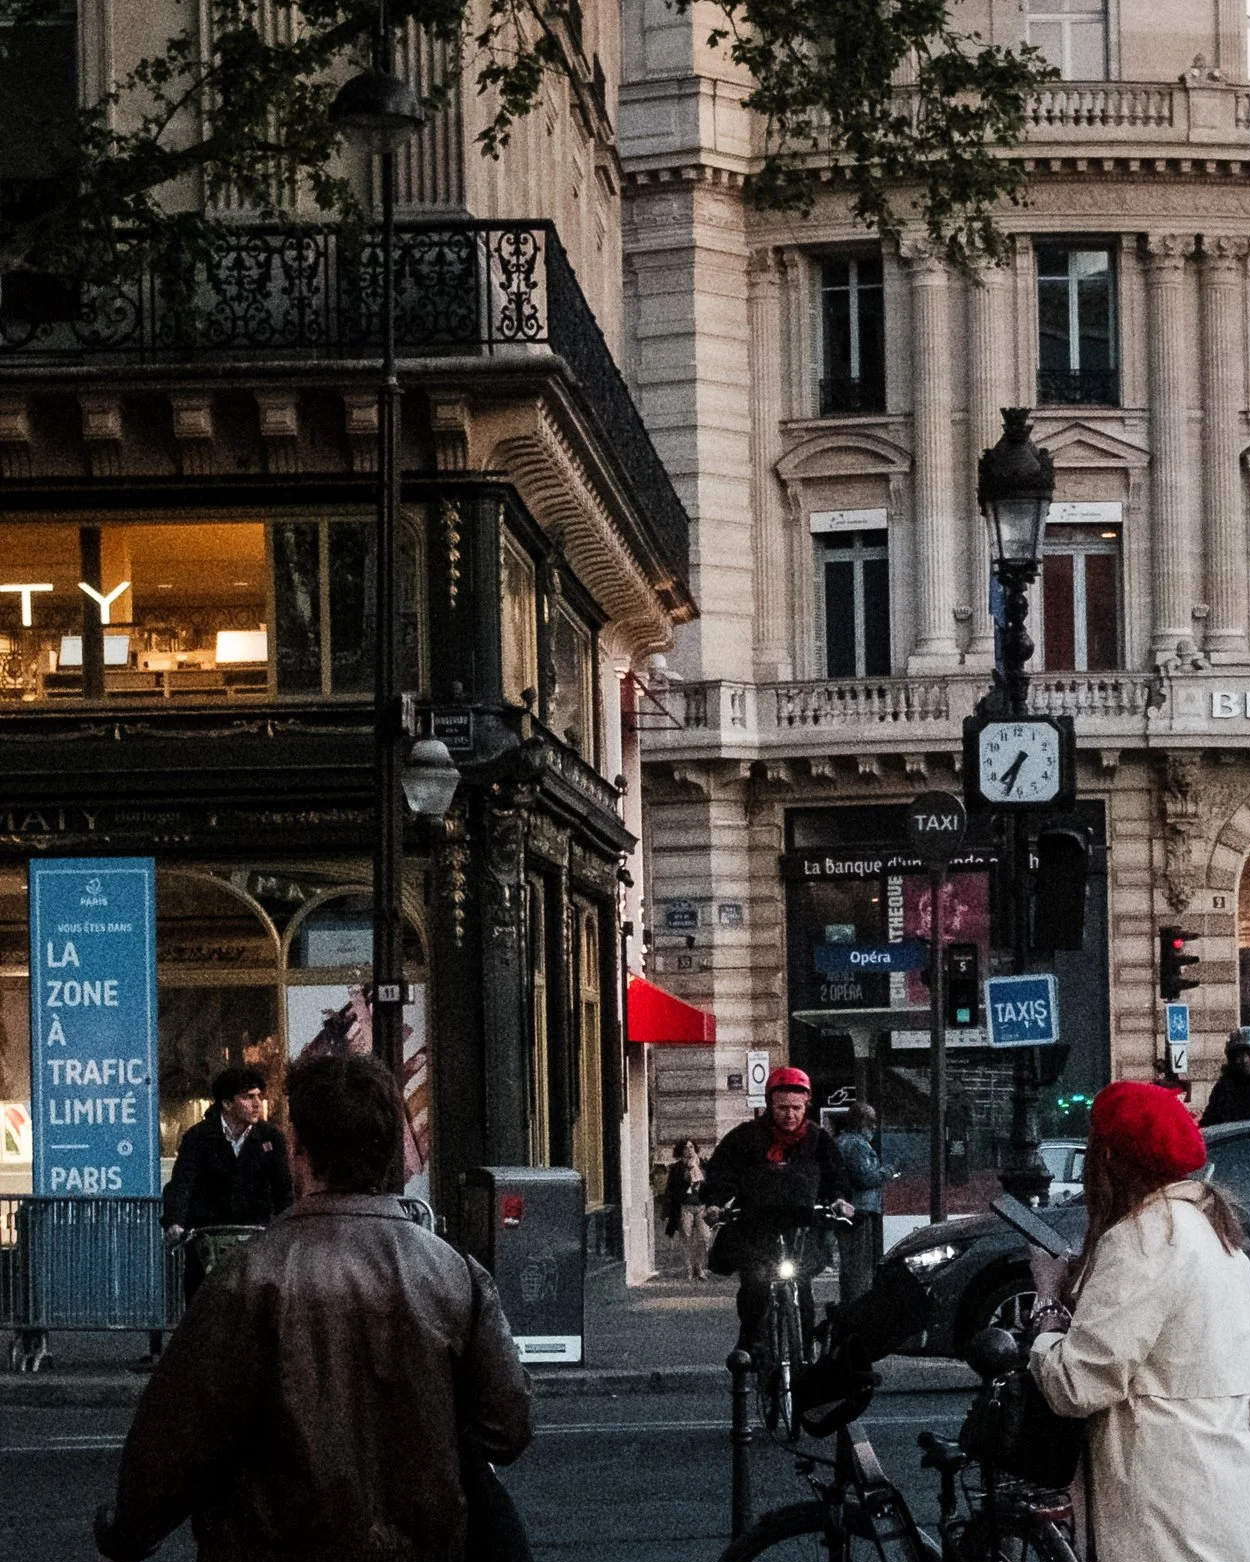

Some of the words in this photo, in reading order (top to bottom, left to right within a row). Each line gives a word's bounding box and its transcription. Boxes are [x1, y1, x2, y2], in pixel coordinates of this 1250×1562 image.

[0, 582, 131, 627] TY
[914, 814, 958, 831] TAXI
[804, 860, 821, 875] La
[80, 897, 108, 906] PARIS
[58, 923, 82, 933] VOUS
[107, 923, 132, 933] DANS
[47, 941, 80, 967] LA
[849, 951, 891, 966] Opéra
[47, 980, 119, 1007] ZONE
[994, 999, 1048, 1023] TAXIS
[47, 1013, 66, 1046] À
[47, 1059, 143, 1085] TRAFIC
[50, 1092, 137, 1125] LIMITÉ
[51, 1166, 122, 1193] PARIS
